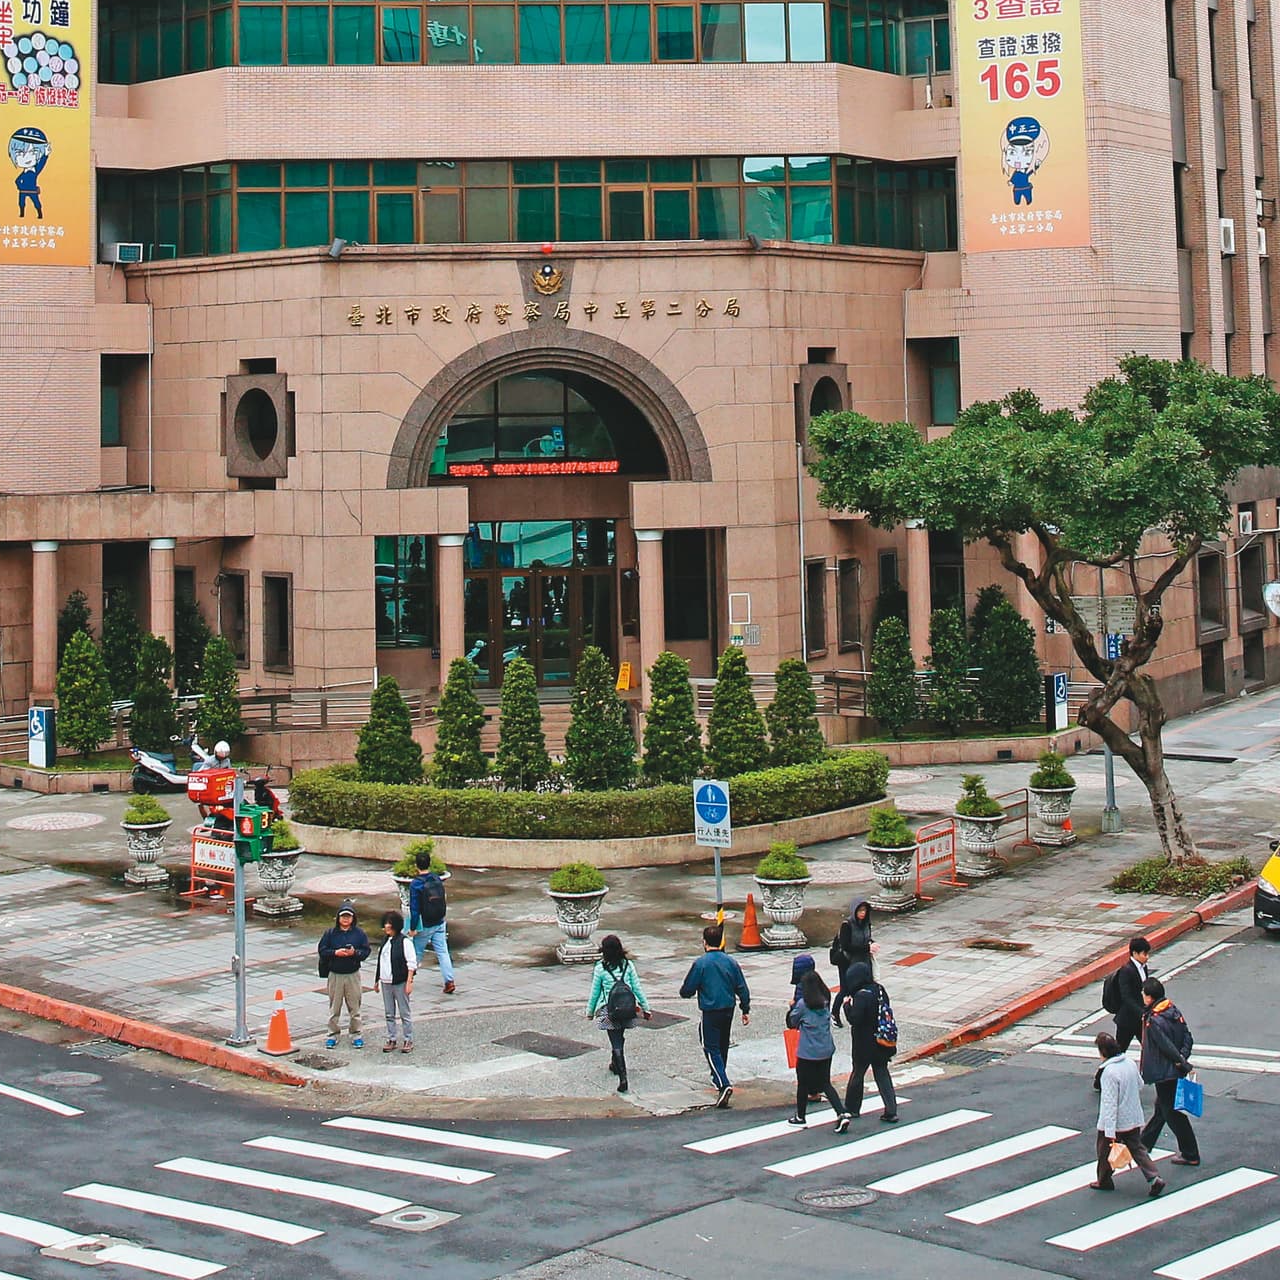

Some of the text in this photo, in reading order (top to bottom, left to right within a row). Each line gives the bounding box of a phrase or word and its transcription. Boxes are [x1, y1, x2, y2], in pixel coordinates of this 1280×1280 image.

[978, 32, 1061, 59] 查證速撥
[980, 59, 1061, 101] 165
[1009, 123, 1038, 135] 中正二
[348, 296, 742, 327] 臺北市政府警察局中正第二分局
[697, 827, 729, 837] 行人優先
